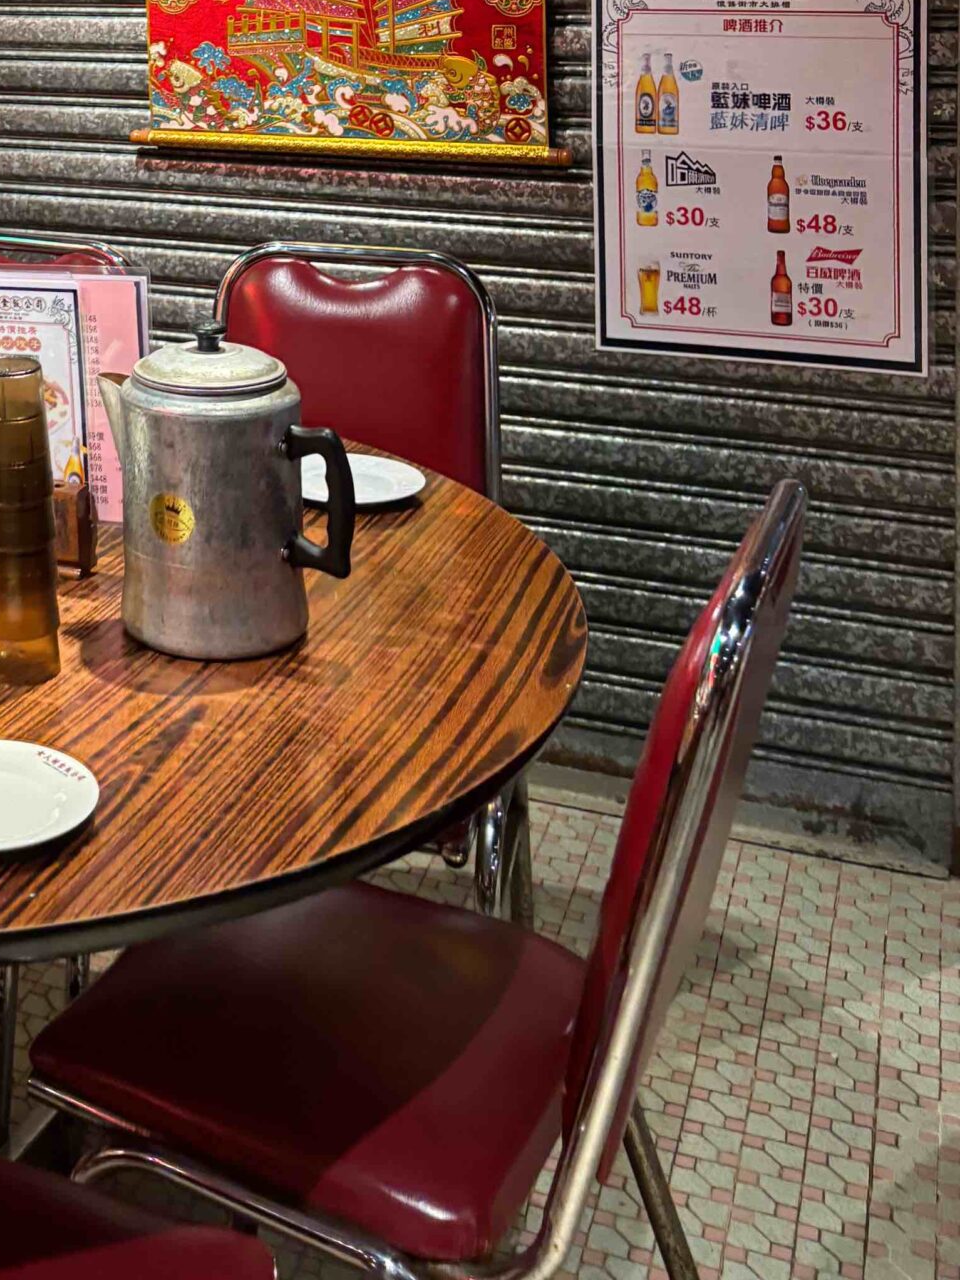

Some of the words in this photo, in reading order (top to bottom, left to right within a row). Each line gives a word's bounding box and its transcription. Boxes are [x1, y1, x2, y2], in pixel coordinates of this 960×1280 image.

[722, 18, 785, 33] 啤酒推介
[710, 91, 792, 112] 藍妹啤酒
[709, 110, 791, 132] 藍妹清啤
[666, 269, 718, 286] PREMIUM
